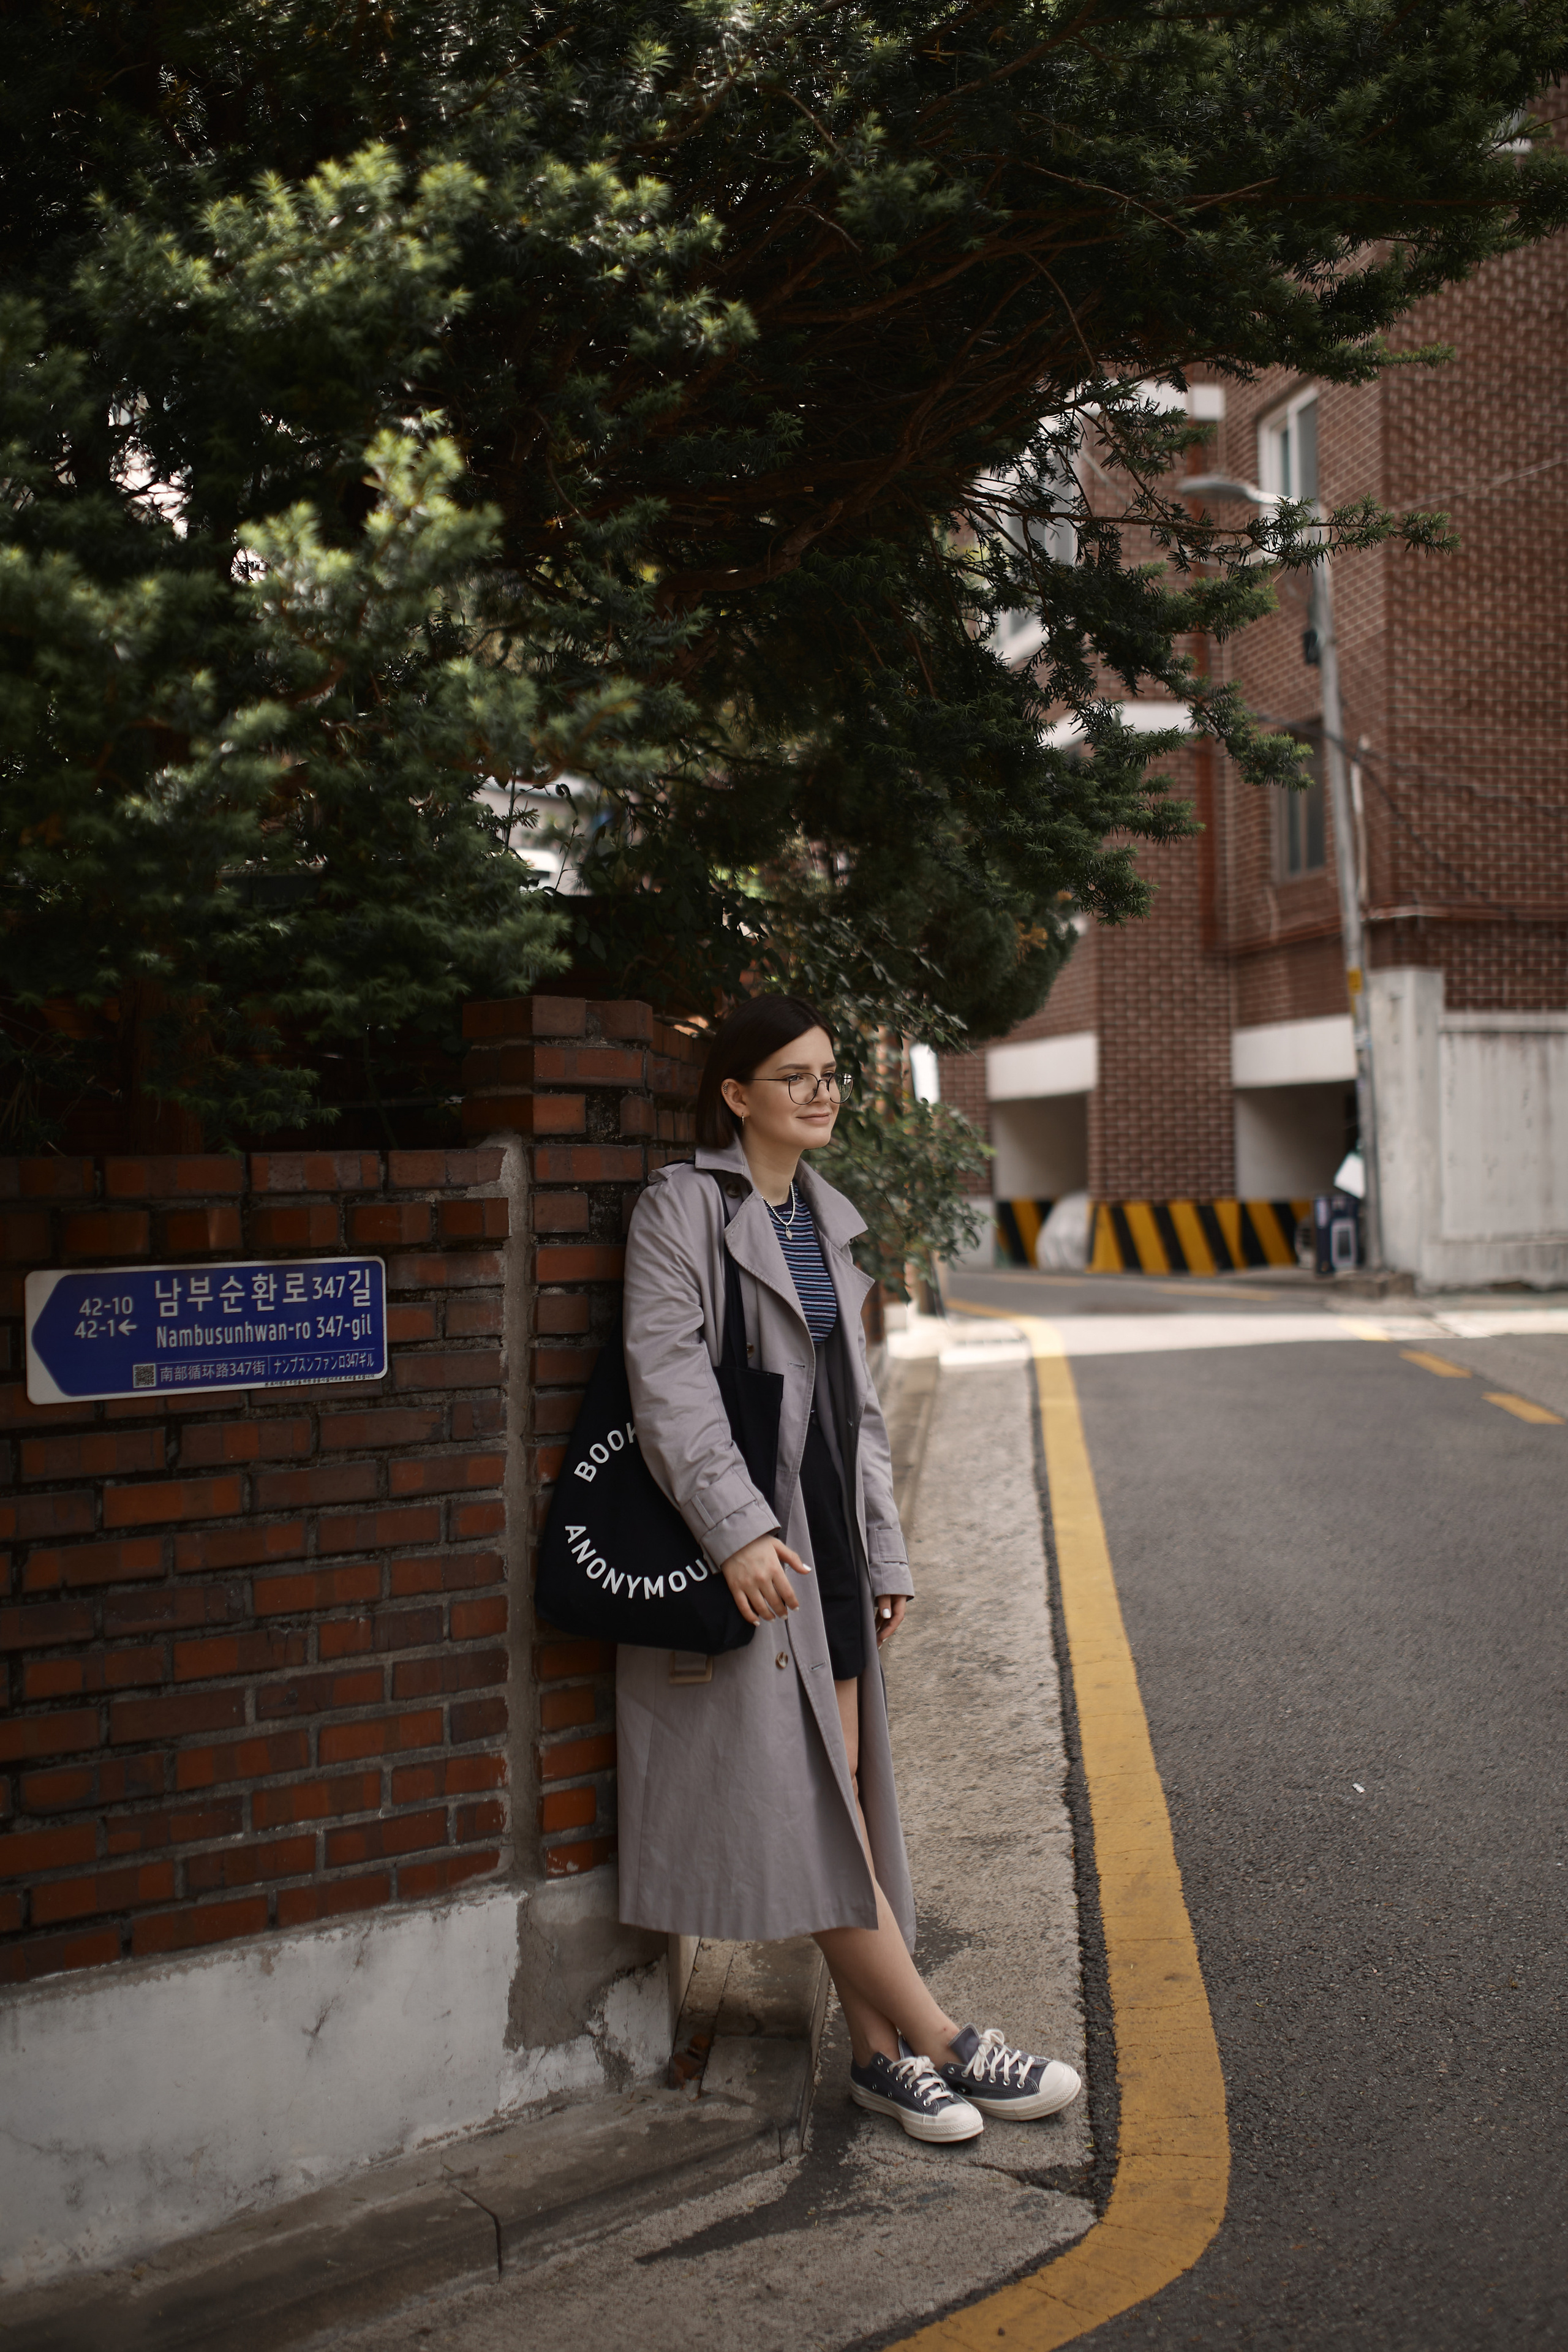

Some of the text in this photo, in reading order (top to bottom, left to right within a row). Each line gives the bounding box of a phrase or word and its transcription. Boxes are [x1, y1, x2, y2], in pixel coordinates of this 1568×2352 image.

[79, 1296, 133, 1316] 42-10
[74, 1319, 115, 1339] 42-1
[156, 1314, 372, 1348] Nambusunhwan-ro 347-gil
[160, 1360, 265, 1382] 南部循环路347街
[574, 1422, 637, 1482] BOOK
[565, 1525, 708, 1600] ANONYMOU
